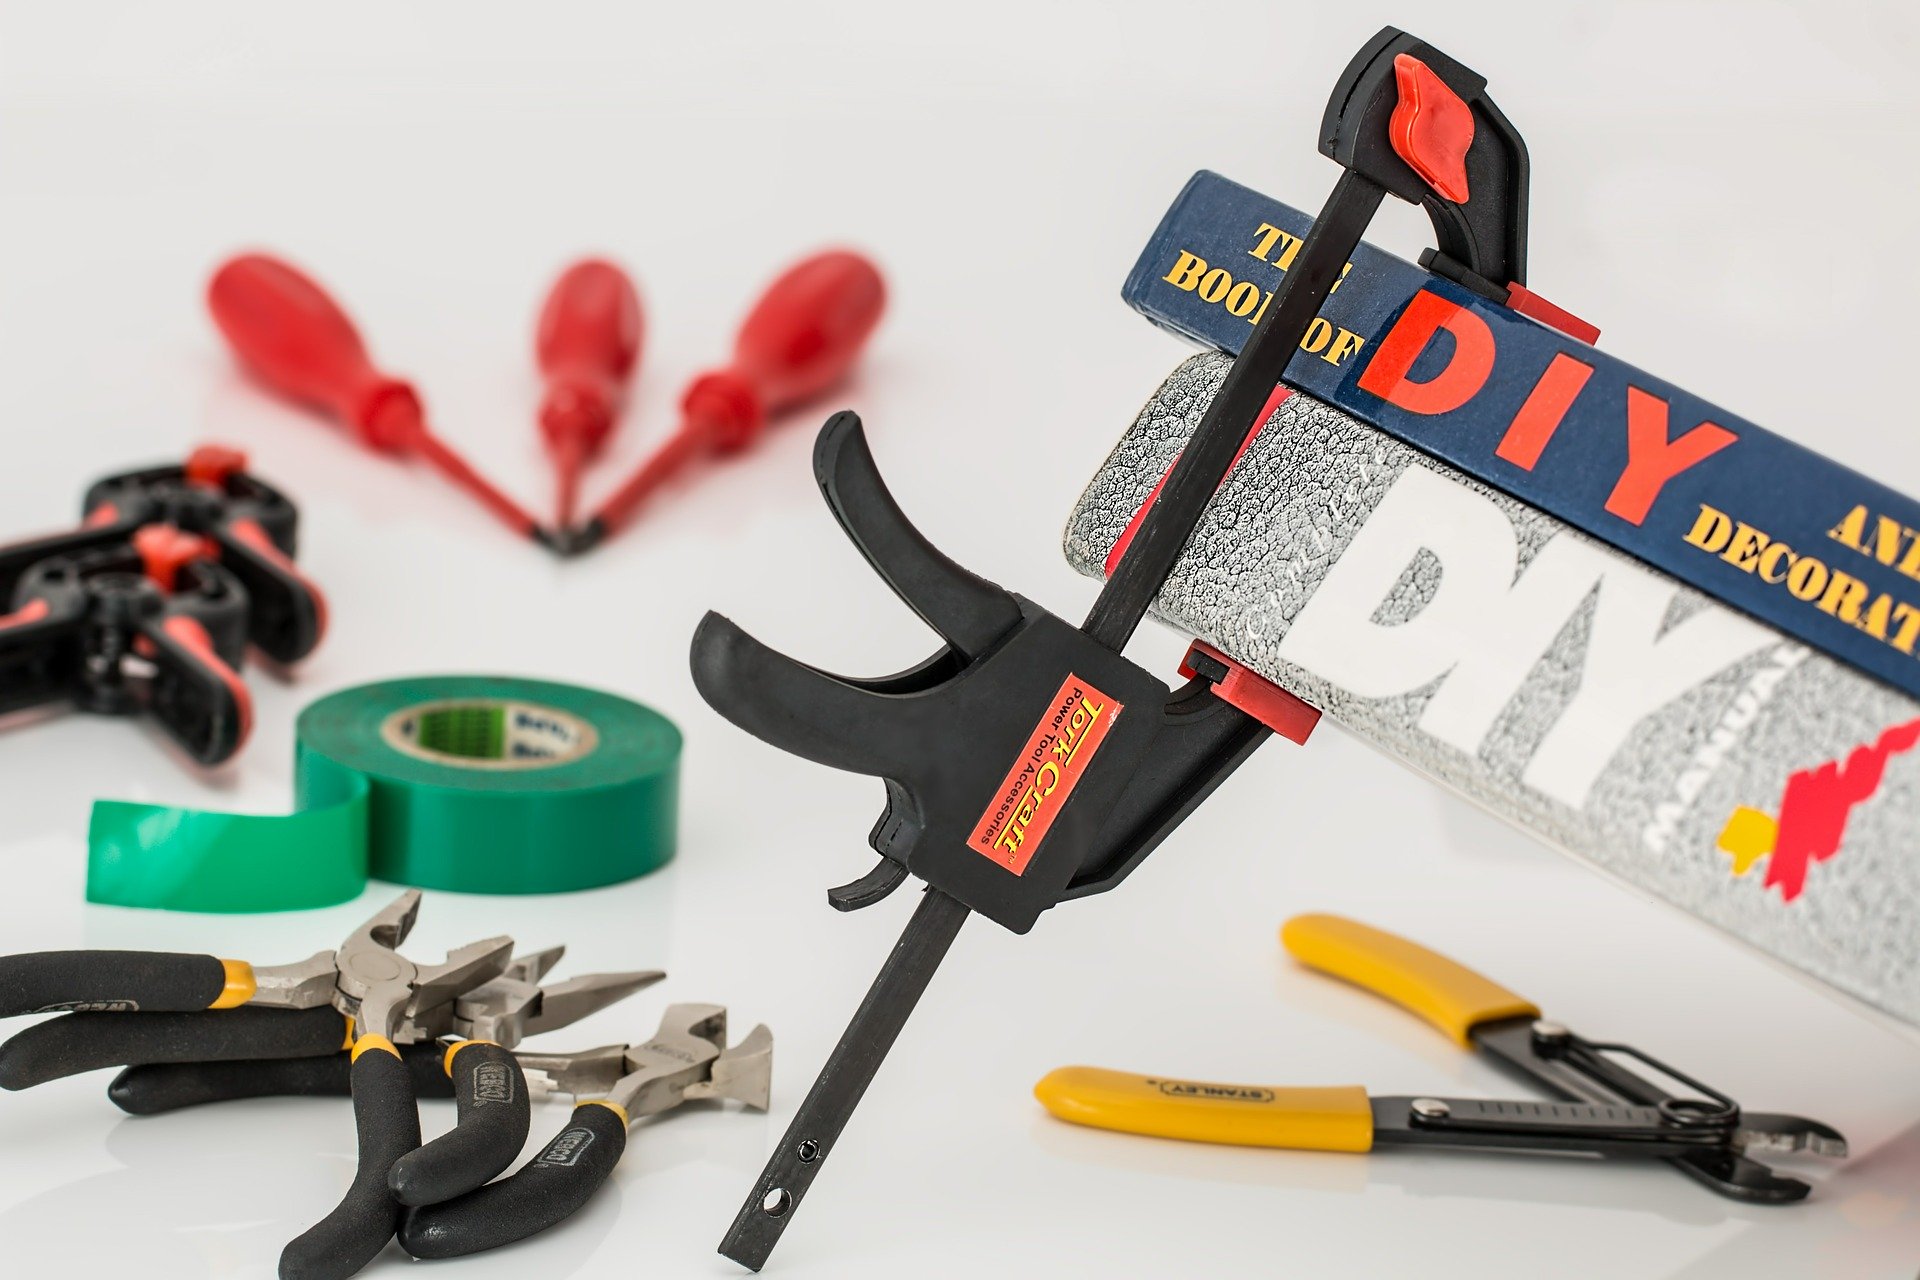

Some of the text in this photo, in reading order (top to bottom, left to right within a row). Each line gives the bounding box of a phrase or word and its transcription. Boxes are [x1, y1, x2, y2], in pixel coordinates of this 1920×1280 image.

[1299, 316, 1366, 366] OF
[1356, 288, 1739, 526] DIY
[1276, 462, 1793, 811] DIY
[1683, 504, 1920, 657] DECORAT
[980, 686, 1083, 845] Power Tool Accessories
[997, 760, 1060, 854] Craft
[1051, 696, 1105, 768] Tork
[1642, 646, 1813, 853] MANUAL
[1171, 1084, 1263, 1099] STANLEY
